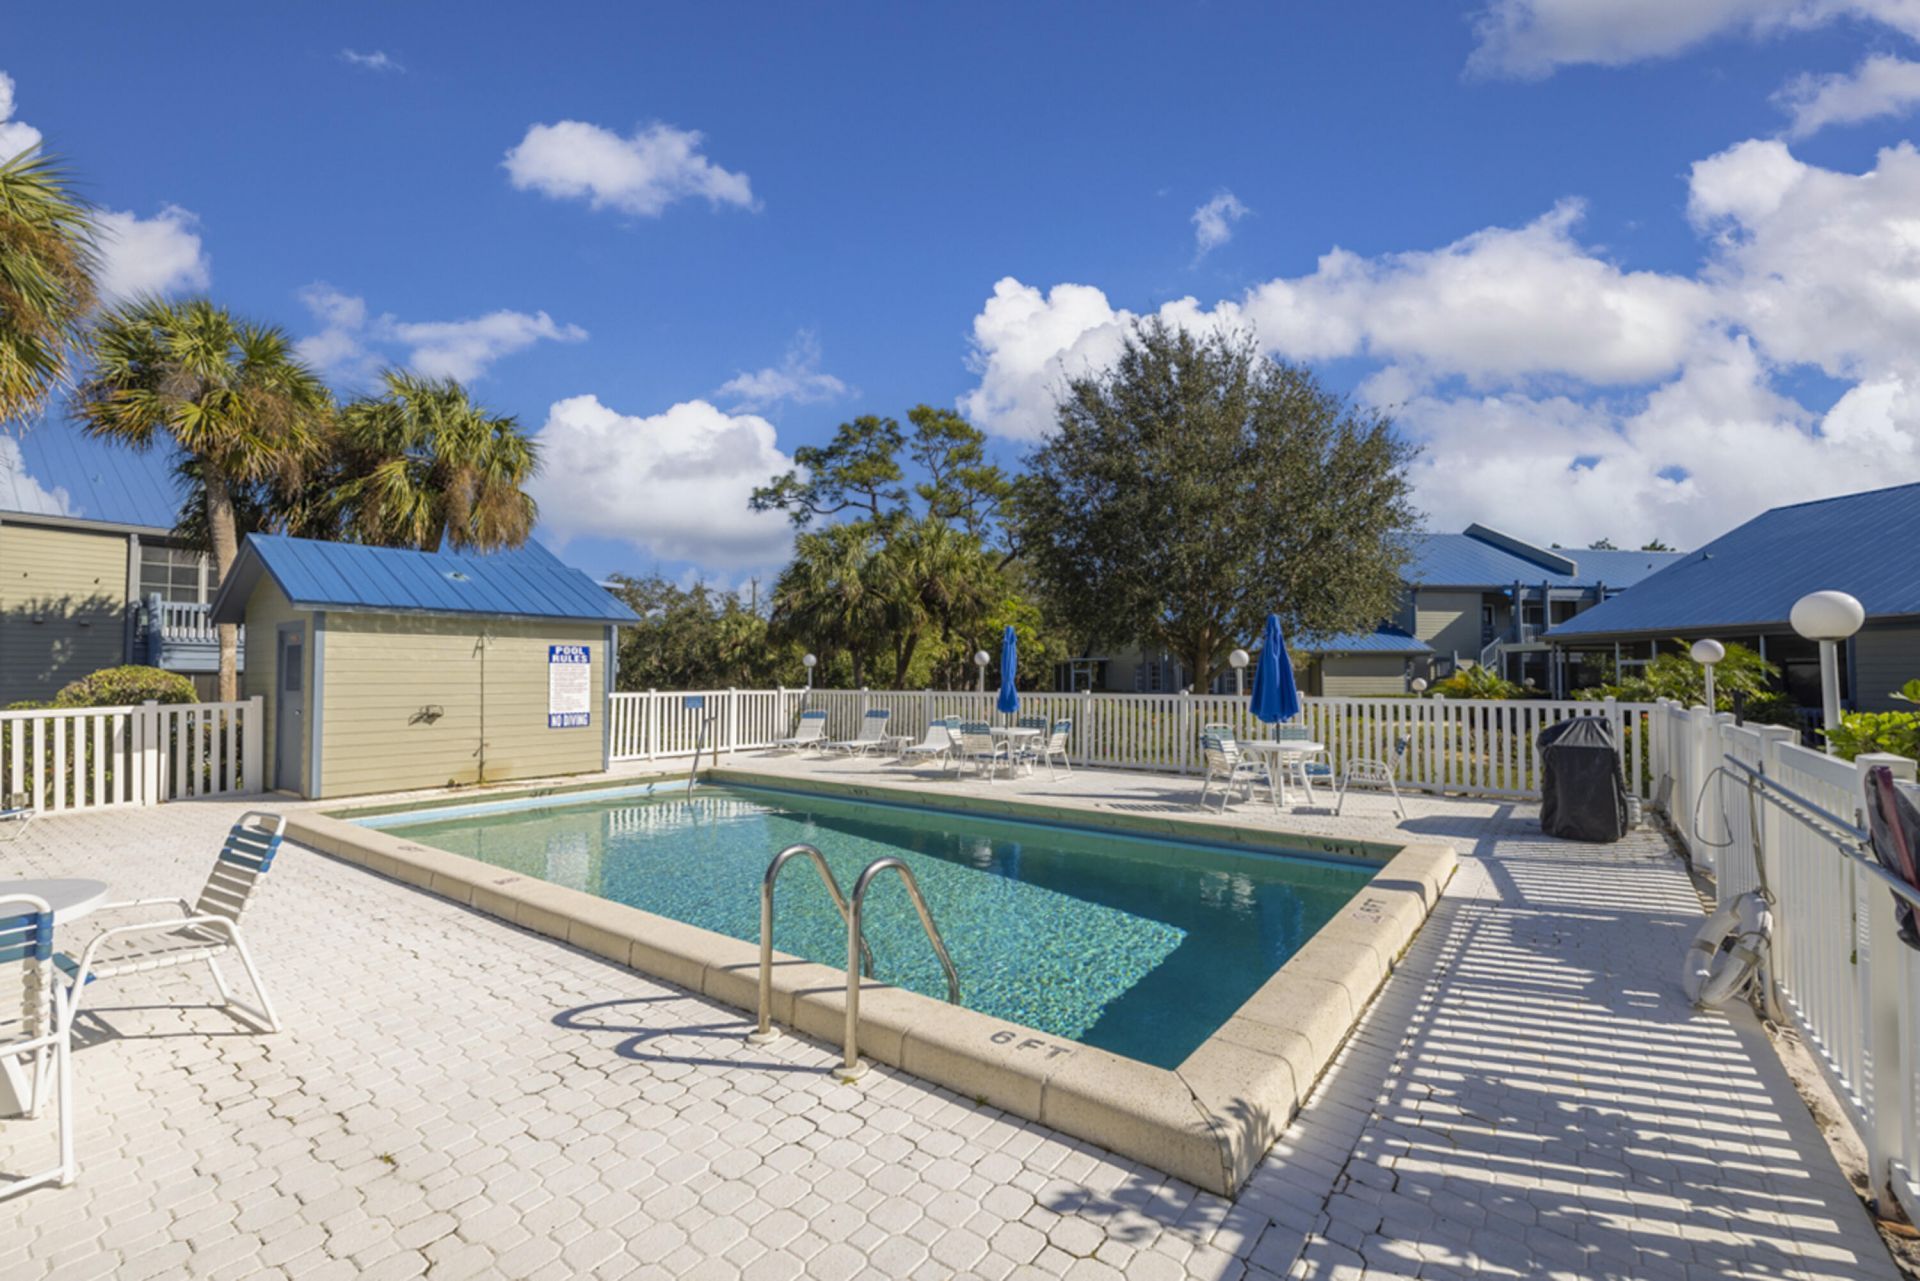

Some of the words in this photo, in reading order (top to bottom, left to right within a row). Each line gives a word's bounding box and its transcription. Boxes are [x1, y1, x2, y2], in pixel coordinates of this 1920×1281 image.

[555, 646, 585, 655] POOL
[552, 655, 588, 663] RULES
[551, 713, 561, 727] NO
[563, 712, 588, 726] DIVING
[990, 1030, 1072, 1060] 6FT
